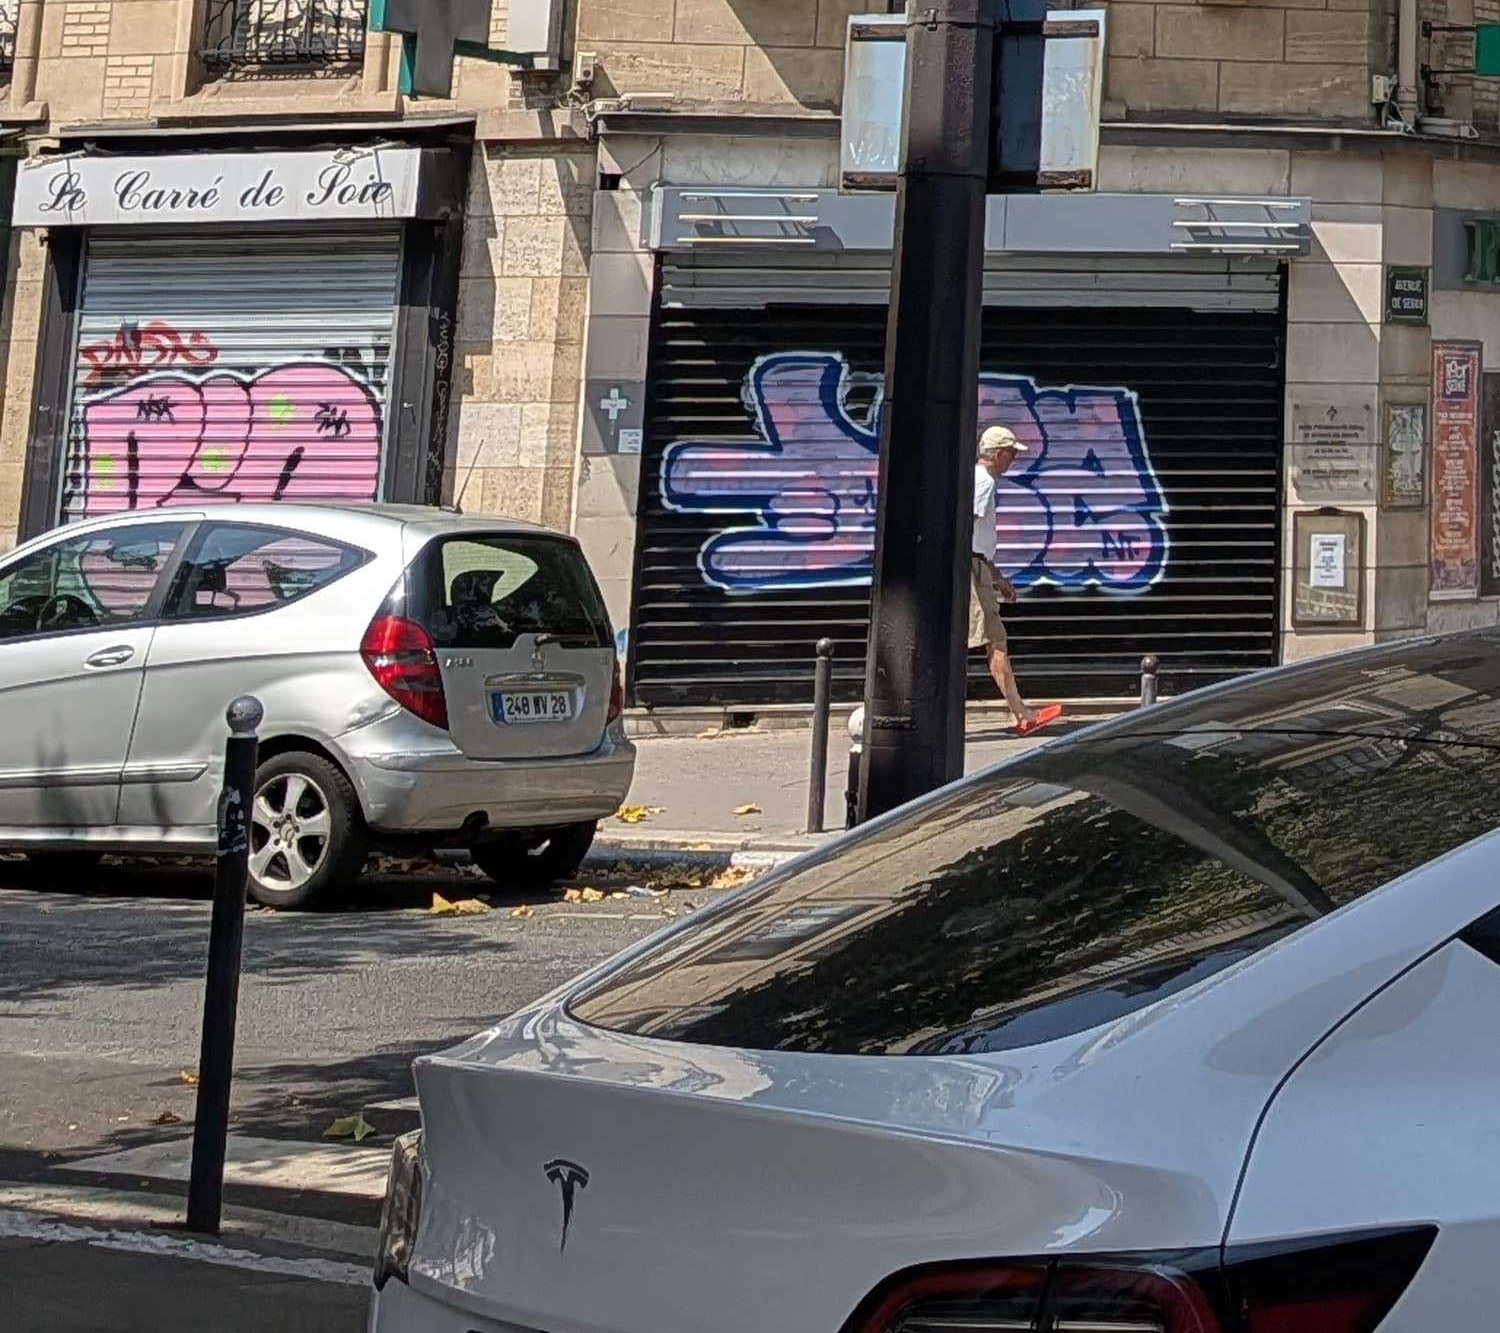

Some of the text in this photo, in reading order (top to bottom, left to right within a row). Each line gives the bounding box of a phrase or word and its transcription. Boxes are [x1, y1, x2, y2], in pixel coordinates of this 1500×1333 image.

[38, 165, 393, 212] Le Carré de Soie
[505, 696, 530, 716] 248
[551, 695, 567, 714] 28
